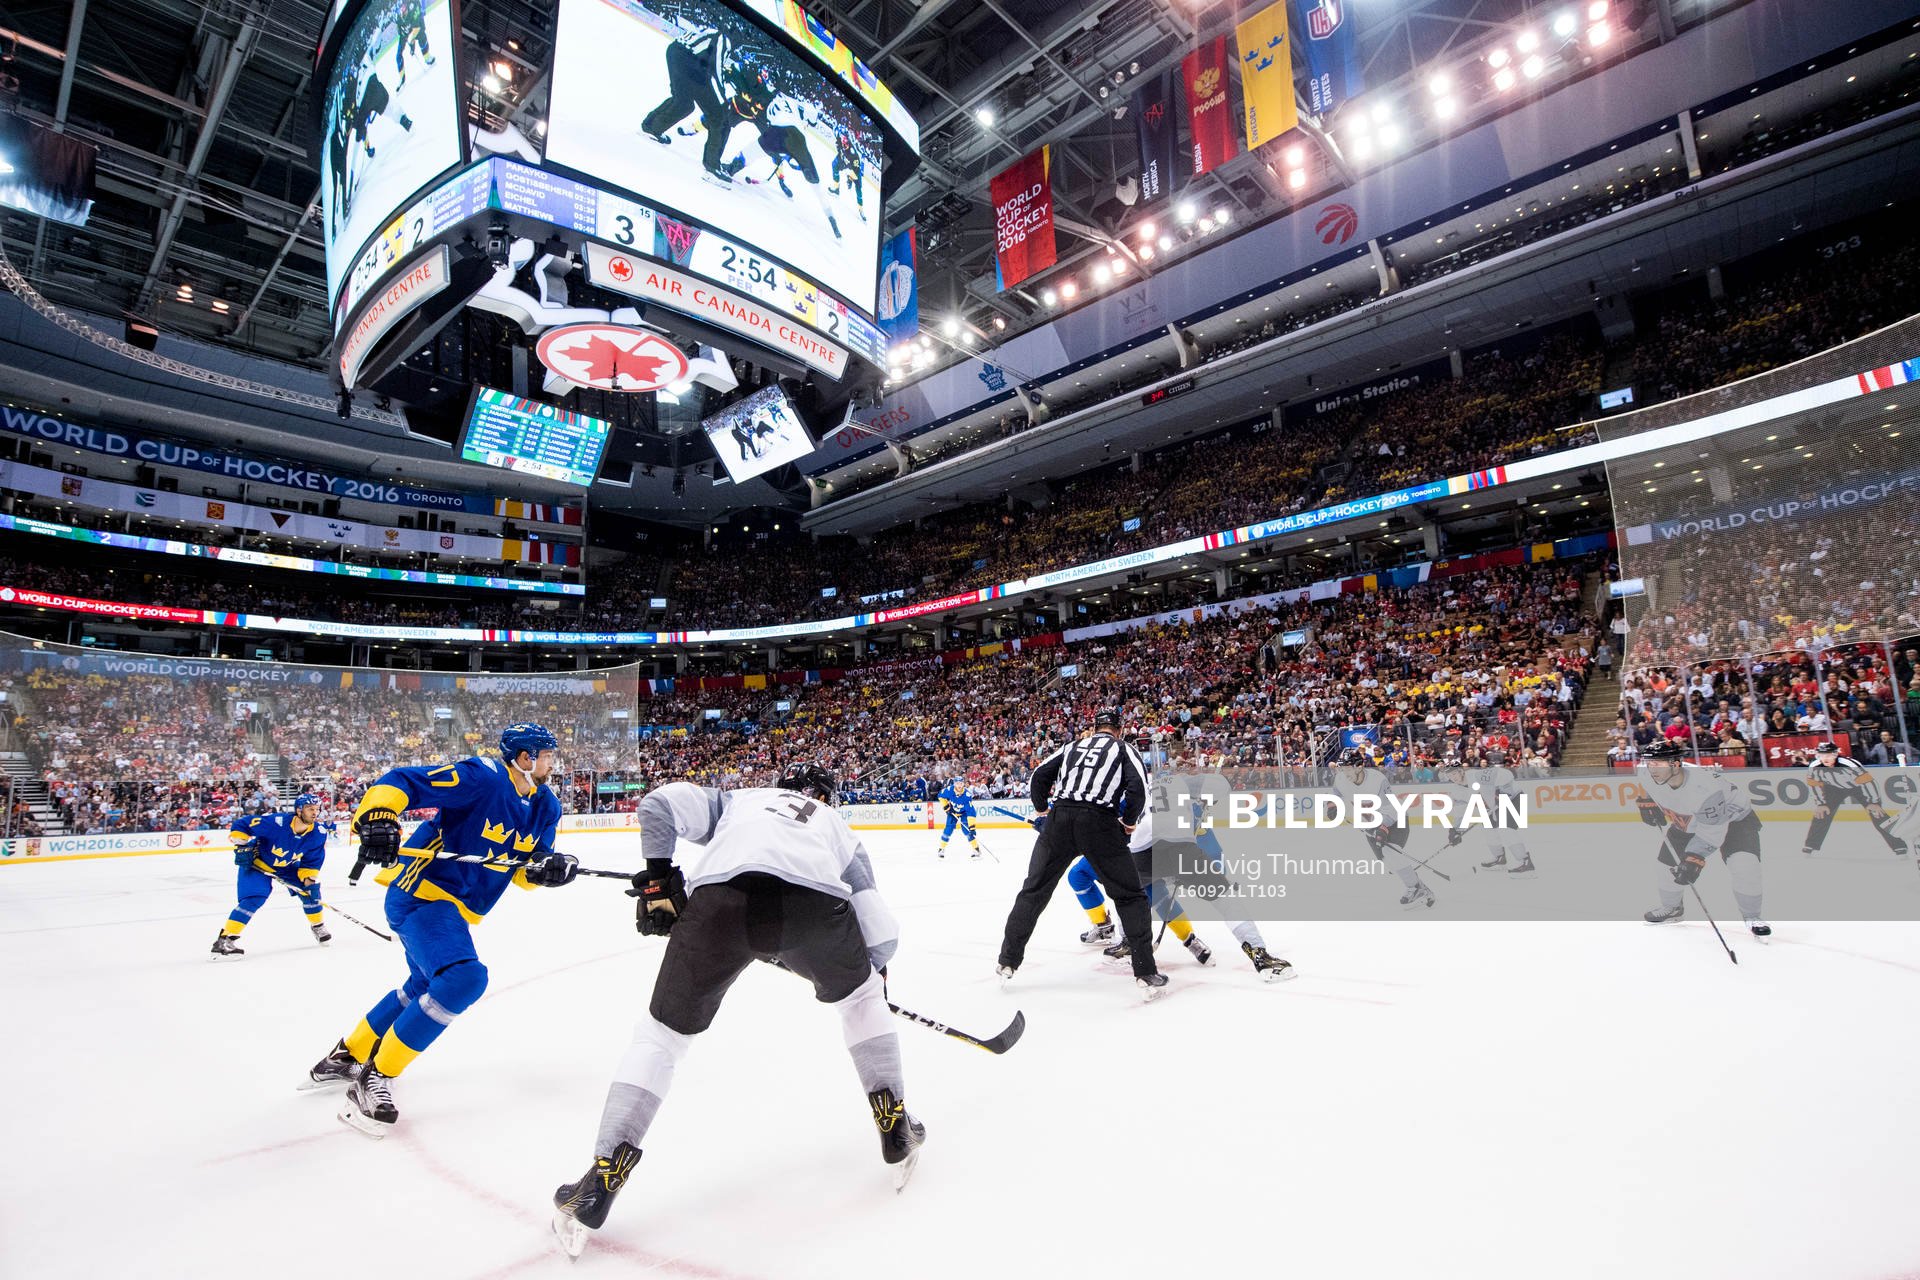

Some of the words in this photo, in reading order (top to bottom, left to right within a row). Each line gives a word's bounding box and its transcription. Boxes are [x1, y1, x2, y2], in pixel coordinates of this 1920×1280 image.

[1310, 78, 1321, 112] UNITED
[1321, 72, 1333, 106] STATES
[1194, 142, 1204, 173] RUSSIA
[506, 162, 548, 181] PARAYKO
[1150, 159, 1159, 194] AMERICA
[505, 182, 546, 199] MCDAVID
[1142, 171, 1151, 200] NORTH
[505, 192, 537, 207] EICHEL
[996, 184, 1042, 217] WORLD
[504, 201, 554, 222] MATTHEWS
[639, 207, 651, 218] 15
[997, 208, 1022, 229] CUP
[1023, 203, 1032, 213] OF
[997, 203, 1049, 241] HOCKEY
[412, 217, 424, 247] 2
[614, 214, 635, 246] 3
[1028, 219, 1049, 234] TORONTO
[998, 231, 1026, 253] 2016
[1824, 234, 1863, 259] 323
[721, 244, 778, 291] 2:54
[354, 301, 385, 344] CANADA
[387, 263, 432, 306] CENTRE
[646, 272, 683, 297] AIR
[693, 290, 772, 333] CANADA
[778, 325, 836, 364] CENTRE
[826, 311, 840, 339] 2
[1168, 381, 1192, 394] CITIZEN
[1252, 419, 1272, 433] 321
[1, 407, 129, 454] WORLD
[135, 440, 200, 466] CUP
[202, 456, 221, 467] OF
[224, 456, 338, 492] HOCKEY
[345, 479, 400, 503] 2016
[405, 491, 463, 506] TORONTO
[1267, 517, 1304, 533] WORLD
[1304, 512, 1327, 525] CUP
[1336, 499, 1382, 518] HOCKEY
[1382, 492, 1410, 507] 2016
[1411, 487, 1441, 498] TORONTO
[1660, 513, 1746, 540] WORLD
[1750, 501, 1800, 523] CUP
[1802, 499, 1818, 510] OF
[101, 532, 111, 545] 2
[190, 545, 201, 556] 3
[400, 570, 409, 581] 2
[1045, 571, 1071, 583] NORTH
[1072, 563, 1107, 577] AMERICA
[1118, 551, 1155, 567] SWEDEN
[484, 577, 492, 588] 4
[18, 591, 63, 607] WORLD
[63, 599, 88, 610] CUP
[95, 602, 144, 616] HOCKEY
[143, 607, 170, 618] 2016
[887, 607, 909, 619] WORLD
[909, 606, 921, 616] CUP
[924, 600, 948, 612] HOCKEY
[948, 597, 961, 607] 2016
[308, 622, 342, 633] NORTH
[344, 625, 385, 636] AMERICA
[398, 626, 437, 637] SWEDEN
[755, 626, 785, 637] AMERICA
[794, 623, 823, 633] SWEDEN
[105, 661, 173, 675] WORLD
[176, 665, 211, 676] CUP
[224, 668, 291, 681] HOCKEY
[845, 666, 875, 678] WORLD
[876, 664, 893, 674] CUP
[898, 659, 933, 671] HOCKEY
[496, 680, 568, 693] #WCH2016
[1075, 748, 1102, 767] 75
[427, 764, 460, 788] 17
[1535, 783, 1612, 808] pizza
[859, 809, 895, 820] HOCKEY
[1011, 804, 1035, 815] CUP
[49, 838, 161, 852] WCH2016.COM
[896, 1007, 950, 1034] CCM
